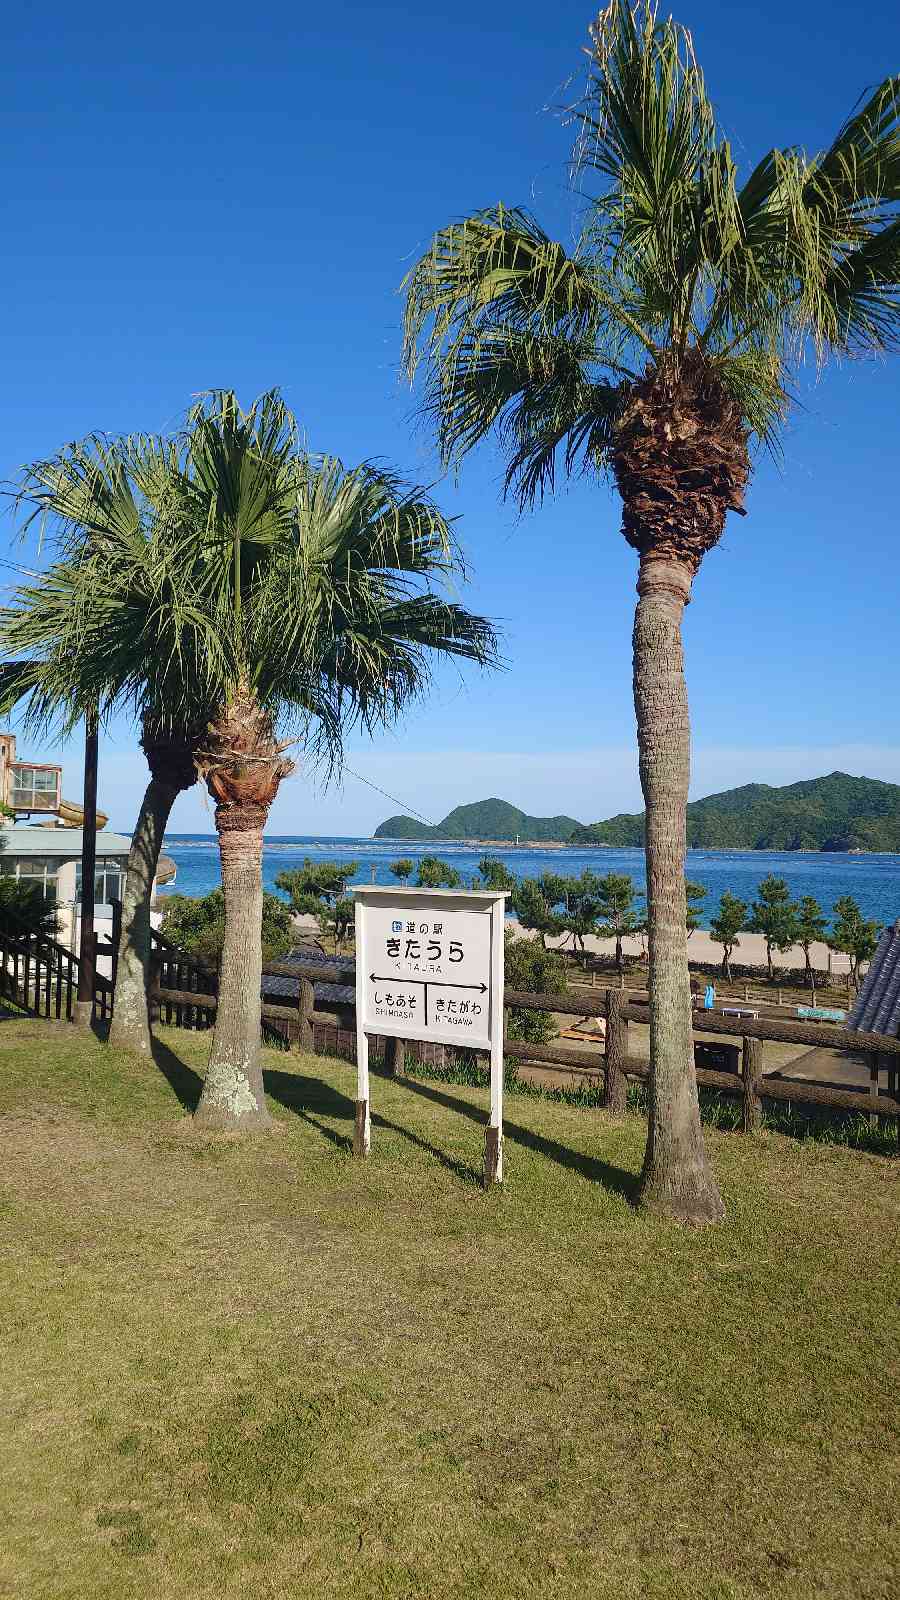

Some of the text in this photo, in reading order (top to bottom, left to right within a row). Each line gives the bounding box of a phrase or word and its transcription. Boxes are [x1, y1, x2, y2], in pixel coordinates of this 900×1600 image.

[406, 921, 443, 935] 道の駅
[386, 938, 464, 963] きたうら
[395, 962, 442, 974] KTAURA
[374, 991, 417, 1009] しもあそ
[436, 998, 482, 1015] きたがわ
[435, 1014, 473, 1026] KTAGAWA
